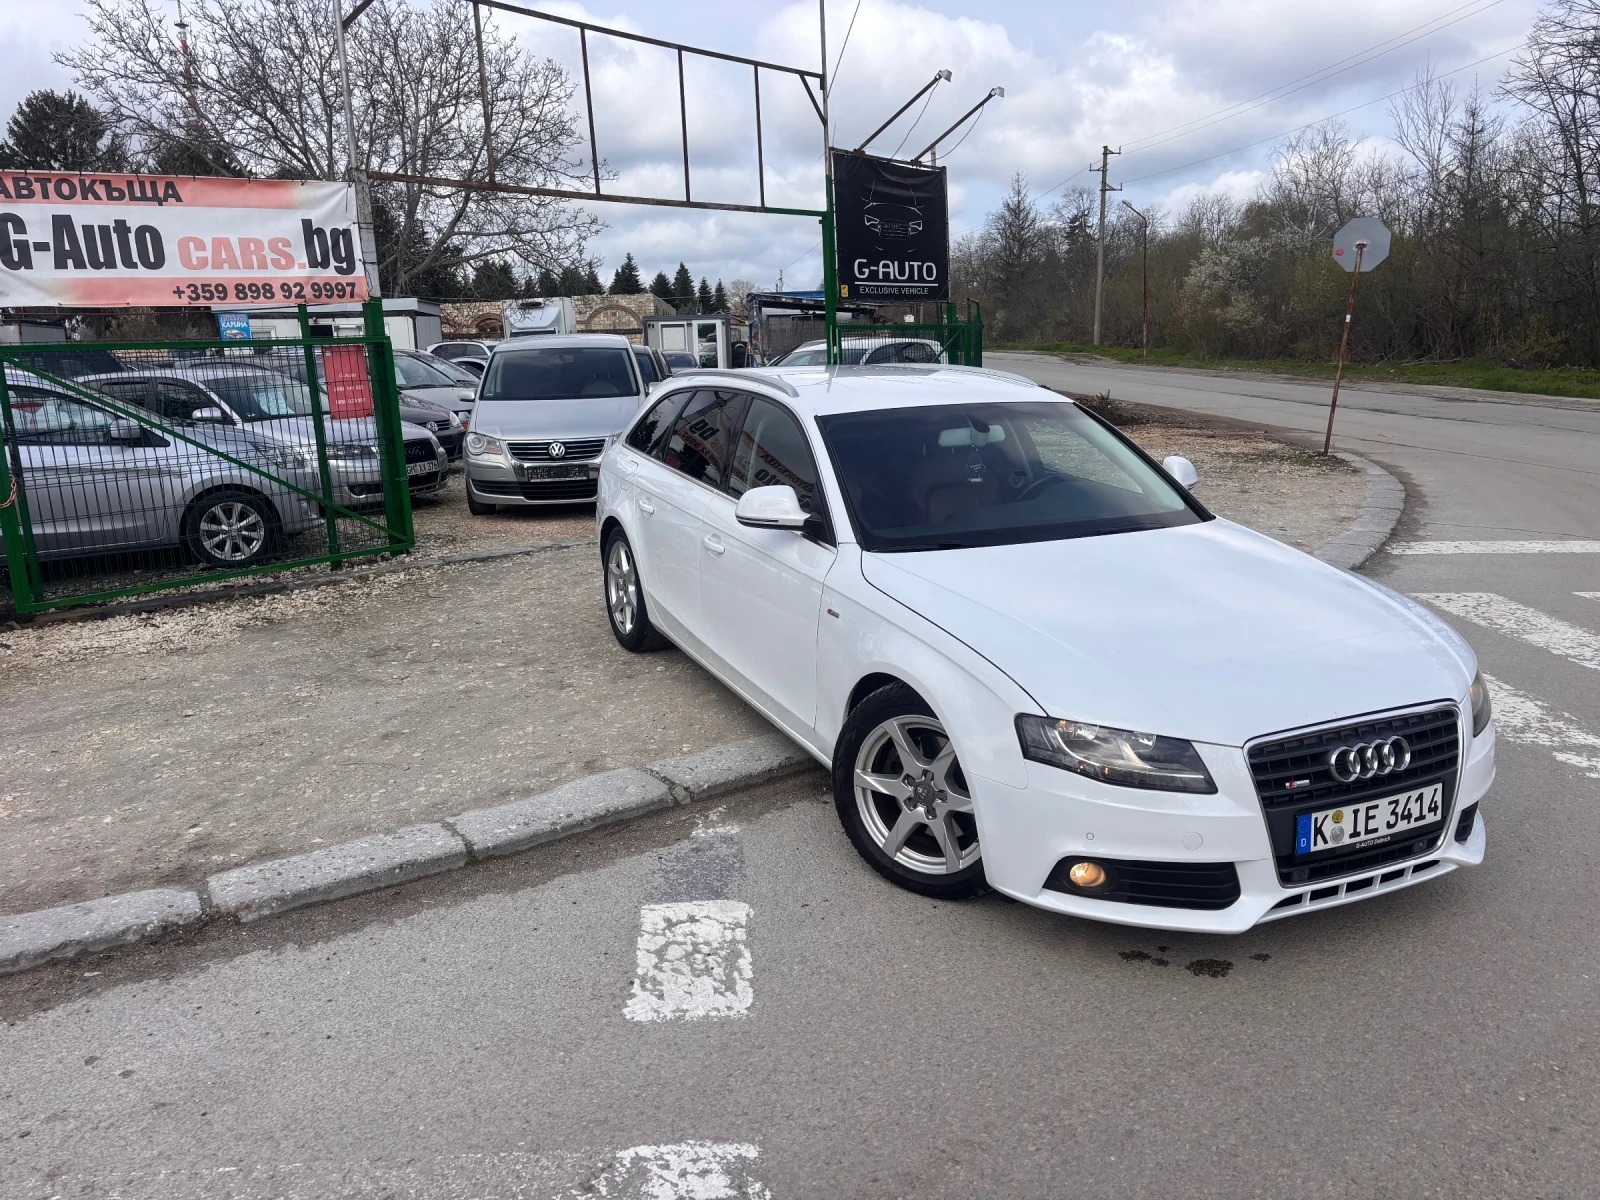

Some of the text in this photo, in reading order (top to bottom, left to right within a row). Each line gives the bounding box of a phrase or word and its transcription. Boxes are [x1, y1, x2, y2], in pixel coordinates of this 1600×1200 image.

[0, 212, 165, 271] G-Auto
[854, 258, 937, 281] G-AUTO
[172, 281, 356, 301] +359 898 92 9997
[859, 286, 929, 295] EXCLUSIVE VEHICLE
[1300, 788, 1439, 848] D K IE 3414
[1355, 840, 1374, 849] G-AUTO
